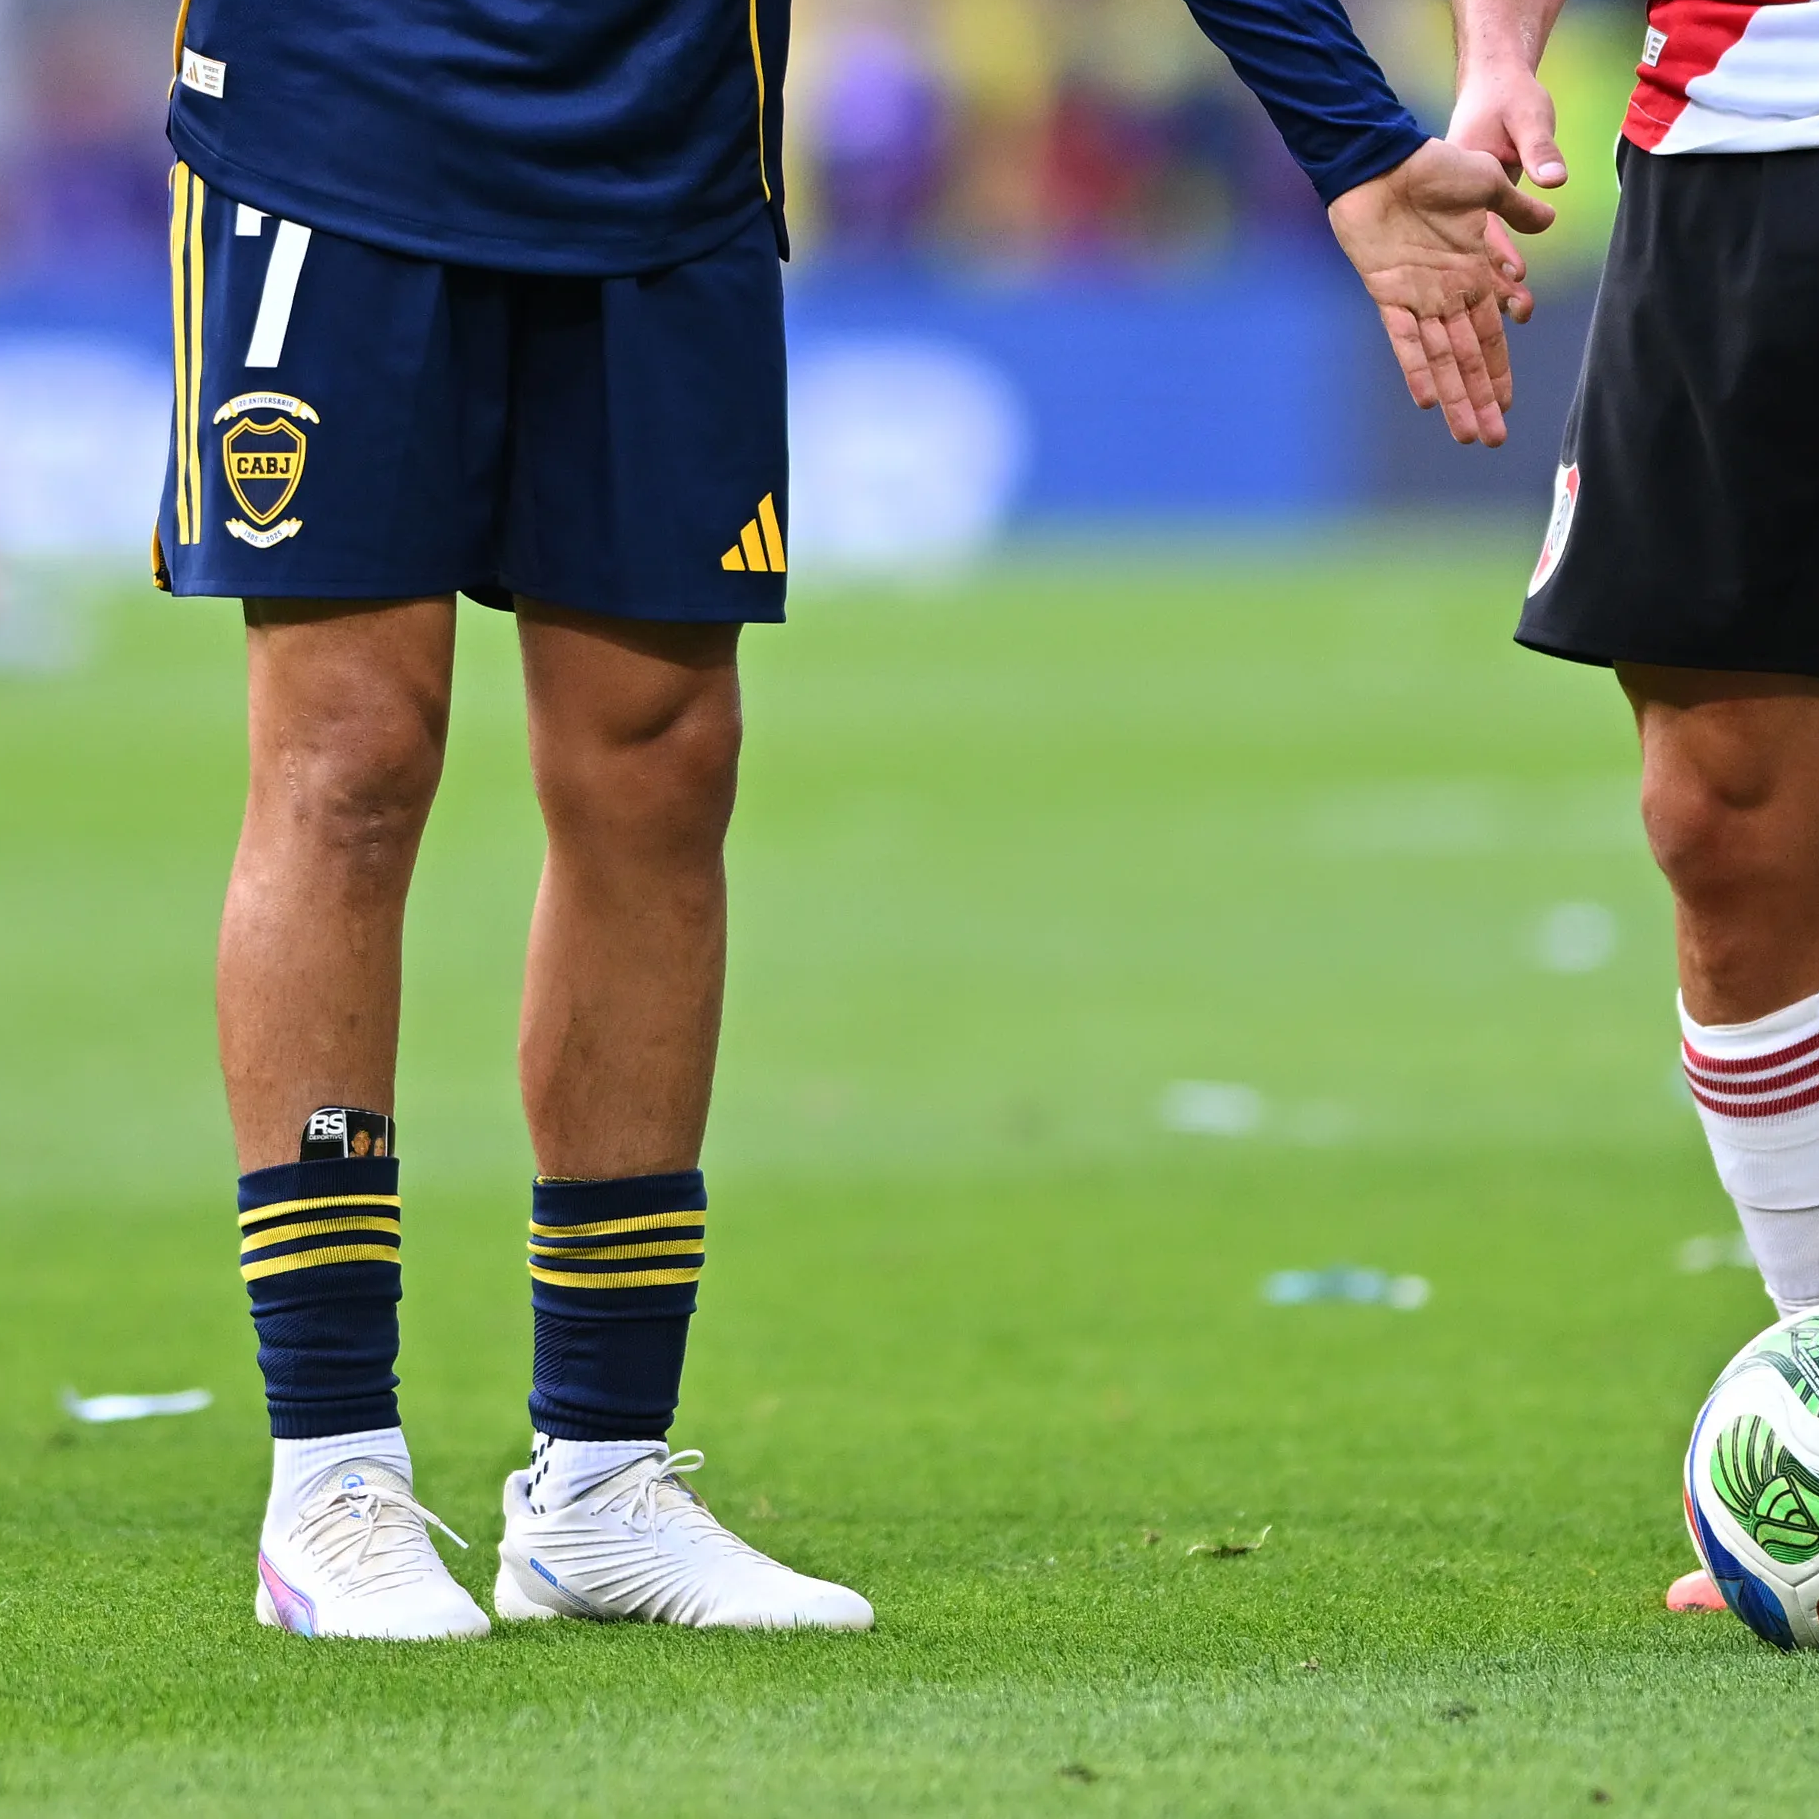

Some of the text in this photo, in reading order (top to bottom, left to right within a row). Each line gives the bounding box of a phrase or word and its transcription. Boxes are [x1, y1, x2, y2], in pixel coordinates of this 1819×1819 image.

[236, 203, 312, 368] 7
[237, 457, 291, 474] CABJ
[309, 1113, 344, 1135] RS
[308, 1133, 343, 1141] DEPORTIVO
